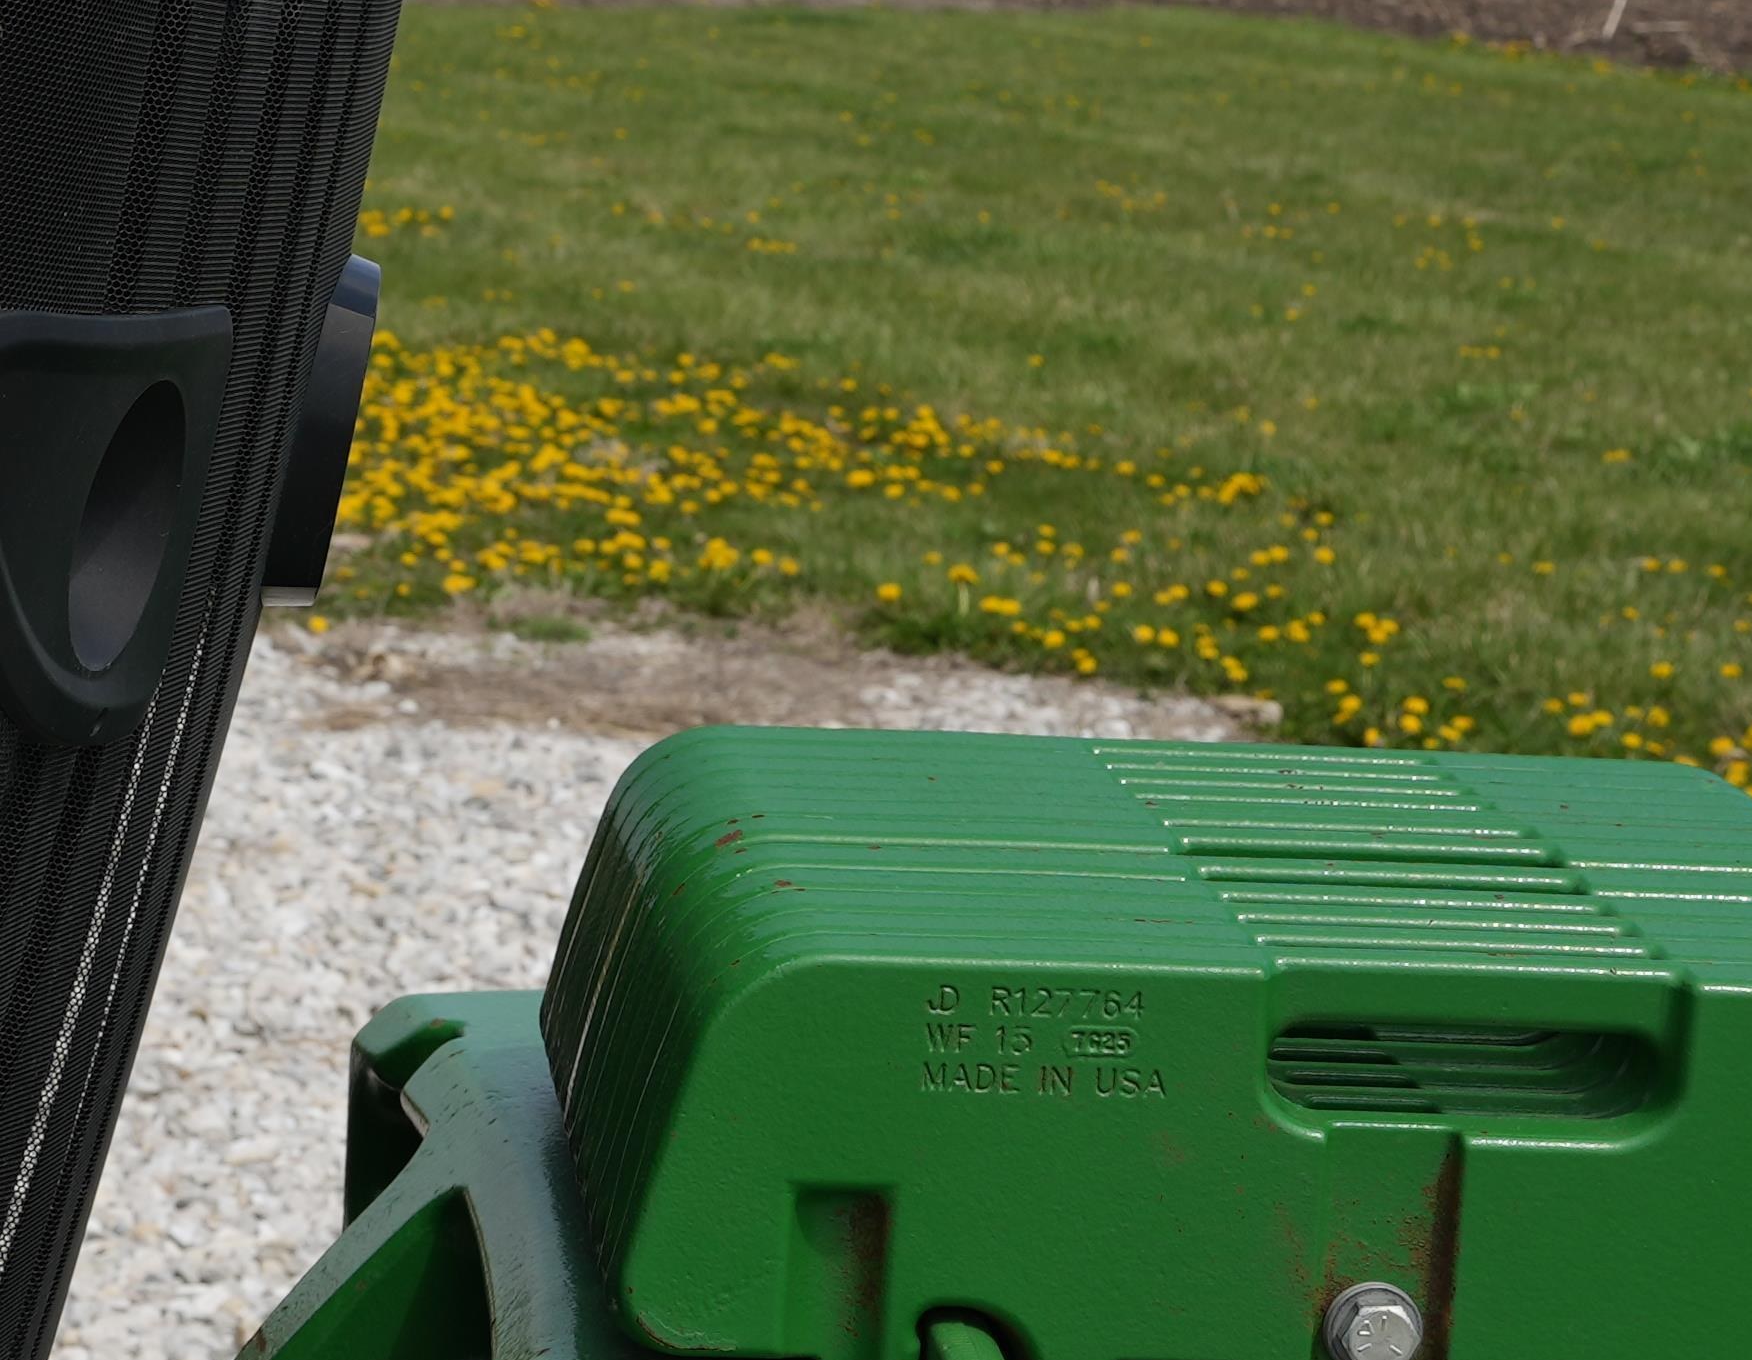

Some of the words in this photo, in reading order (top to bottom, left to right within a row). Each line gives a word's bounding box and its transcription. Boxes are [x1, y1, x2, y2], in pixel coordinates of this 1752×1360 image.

[926, 984, 960, 1016] JD
[989, 986, 1145, 1021] R127764
[925, 1022, 977, 1054] WF
[995, 1025, 1033, 1056] 15
[921, 1061, 1022, 1094] MADE
[1037, 1065, 1074, 1097] IN
[1095, 1067, 1167, 1099] USA
